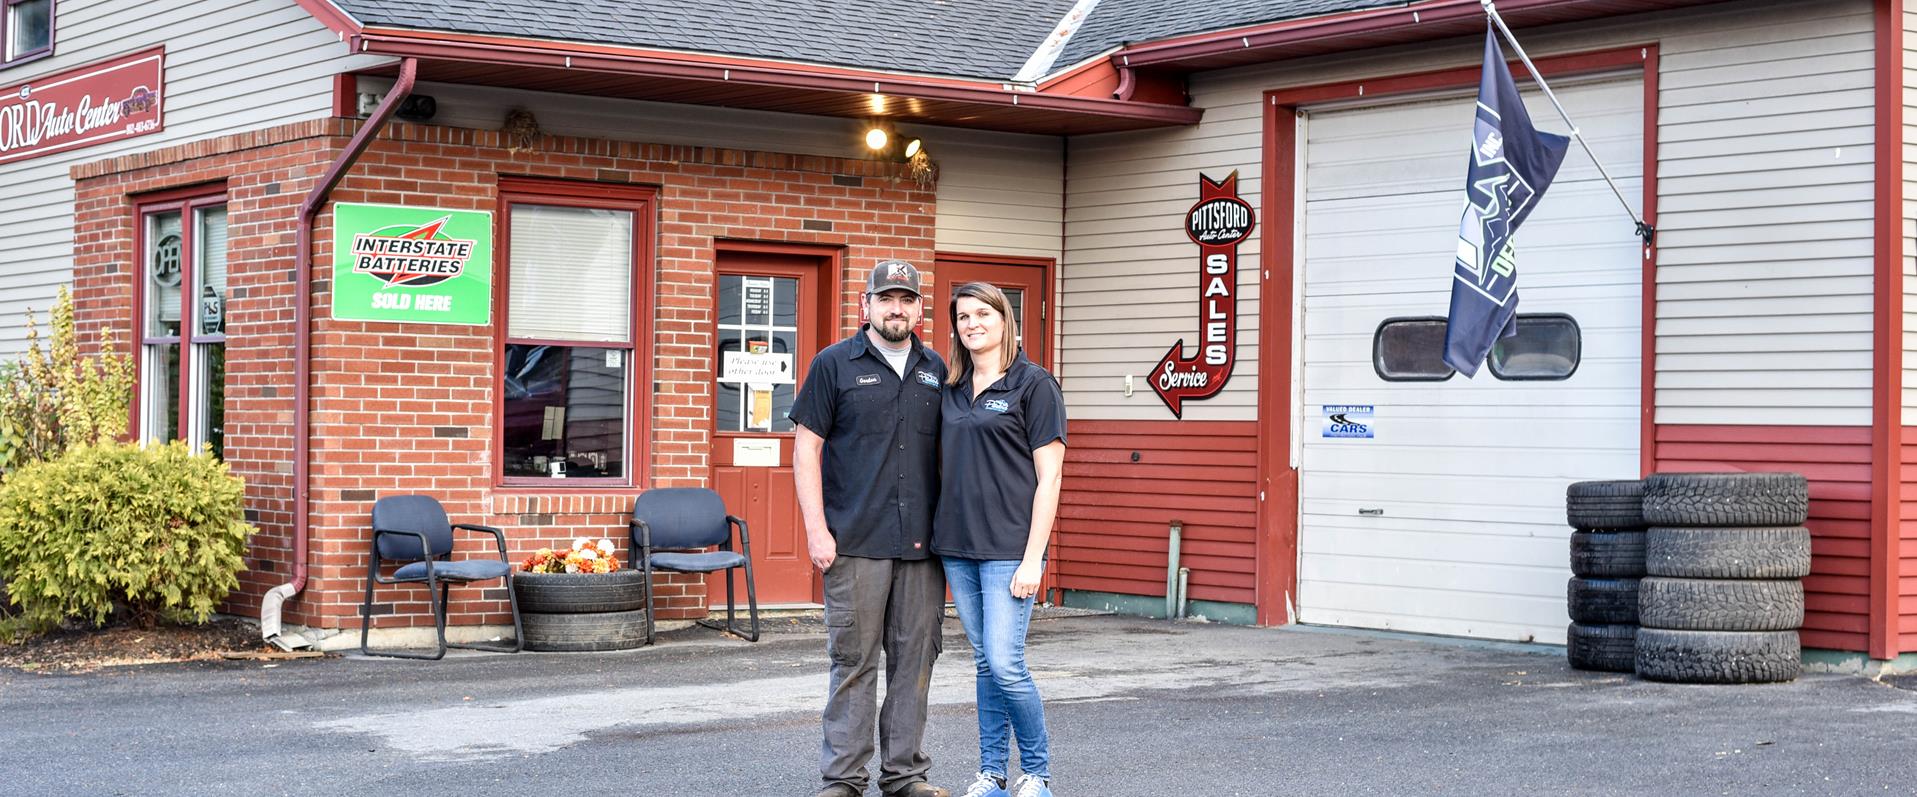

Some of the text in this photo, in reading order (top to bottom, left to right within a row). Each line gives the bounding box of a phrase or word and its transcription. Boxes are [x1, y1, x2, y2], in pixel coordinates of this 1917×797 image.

[31, 102, 74, 146] Auto
[75, 94, 121, 134] Center
[1192, 201, 1248, 231] PITTSFORD
[1199, 228, 1243, 241] Auto Center
[356, 238, 470, 257] INTERSTATE
[359, 256, 461, 274] BATTERIES
[371, 292, 453, 311] SOLD HERE
[1205, 253, 1229, 365] SALES
[1159, 360, 1208, 391] Service
[1330, 424, 1368, 433] CARS
